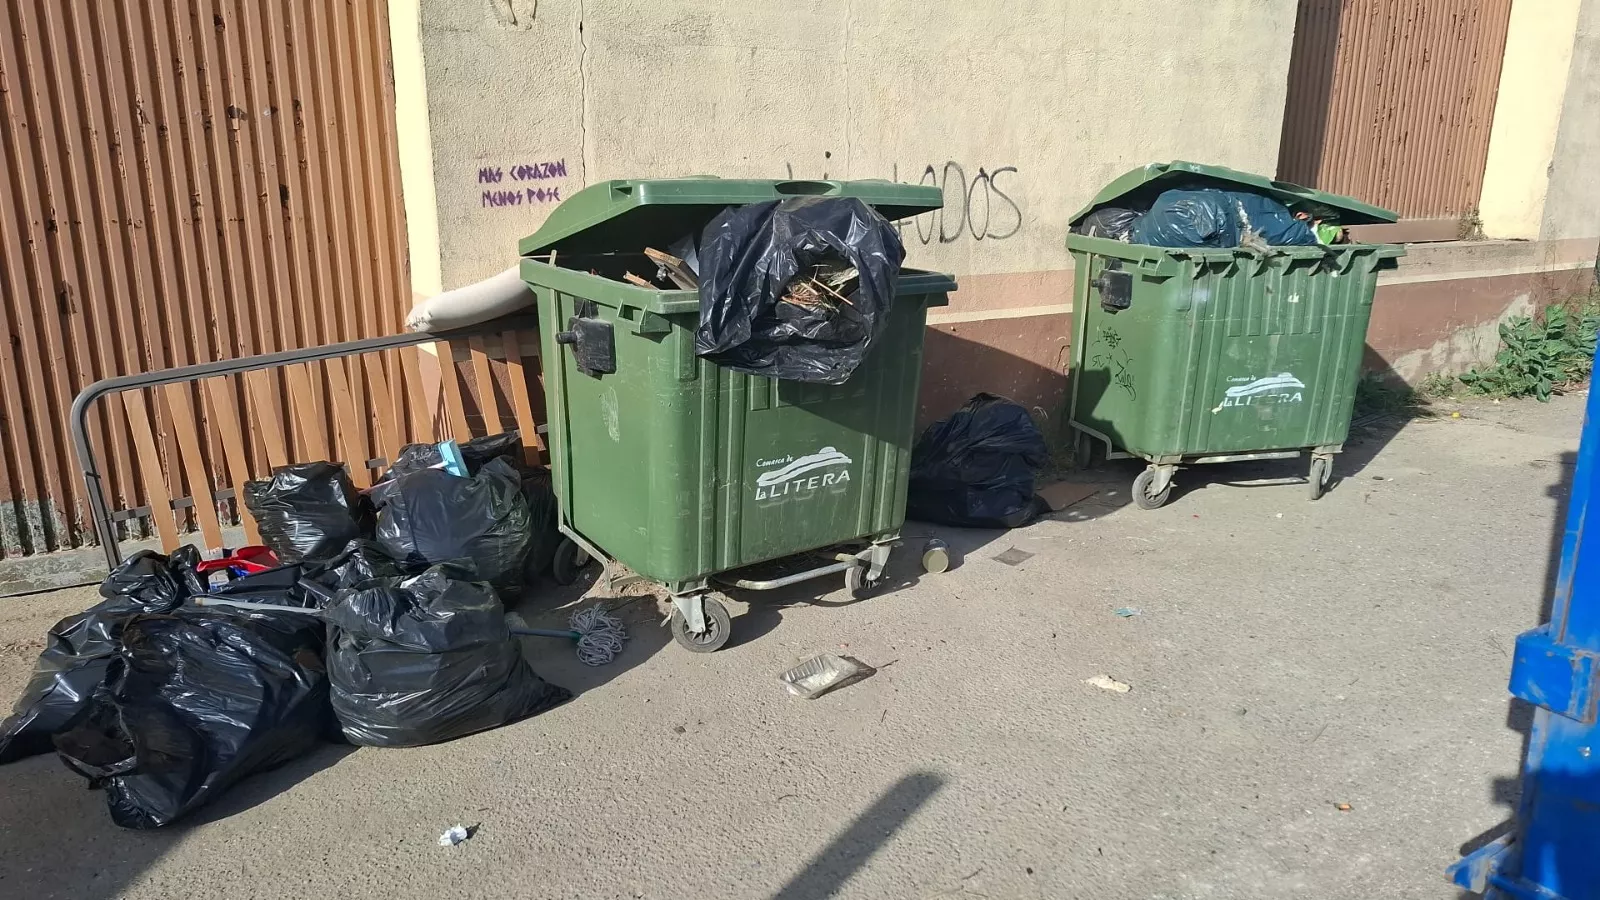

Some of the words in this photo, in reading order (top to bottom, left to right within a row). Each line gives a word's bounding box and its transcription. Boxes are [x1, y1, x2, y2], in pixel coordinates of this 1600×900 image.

[479, 167, 502, 183] MAS
[510, 158, 567, 180] CORAZON
[482, 190, 522, 207] MENOS
[527, 187, 561, 203] POSE
[755, 487, 767, 501] la
[770, 470, 851, 498] LITERA
